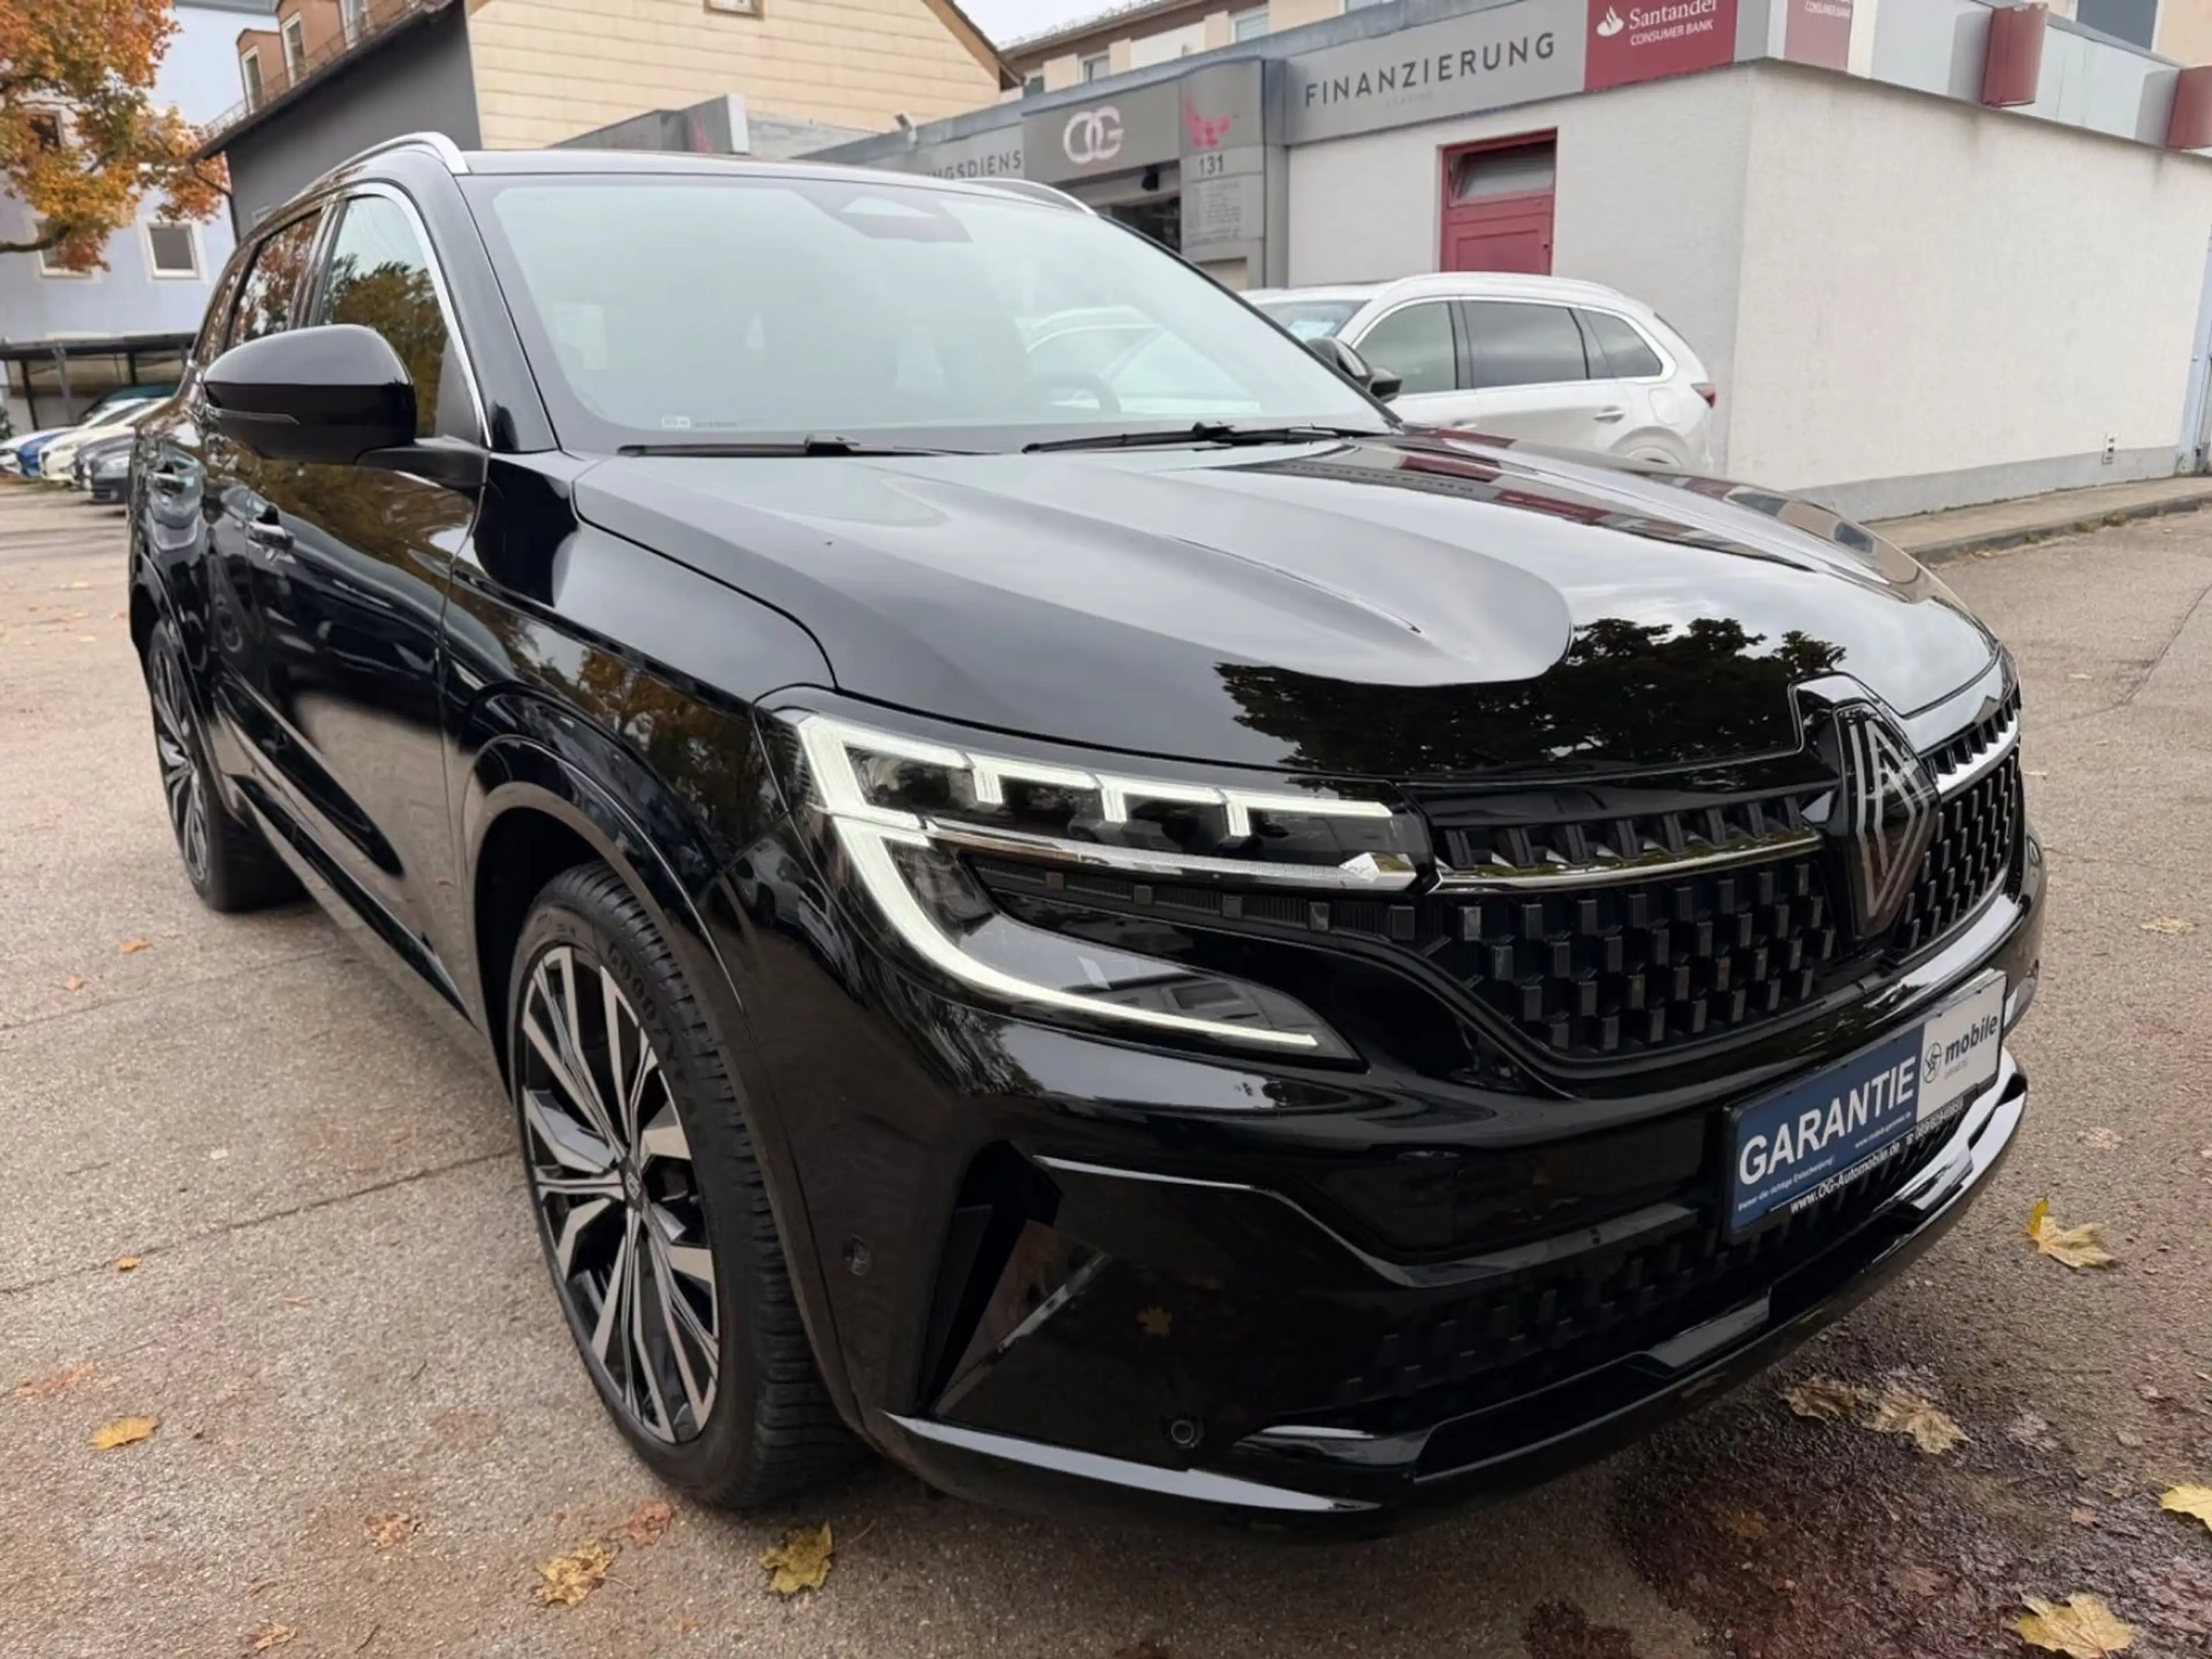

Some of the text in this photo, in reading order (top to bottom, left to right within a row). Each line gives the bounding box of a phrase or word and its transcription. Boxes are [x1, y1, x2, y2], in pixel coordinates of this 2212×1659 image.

[1628, 0, 1717, 29] Santander
[1630, 19, 1714, 45] CONSUMER BANK
[1305, 32, 1555, 108] FINANZIERUNG
[1200, 154, 1224, 176] 131
[1945, 1015, 1998, 1065] mobile
[1739, 1056, 1916, 1185] GARANTIE
